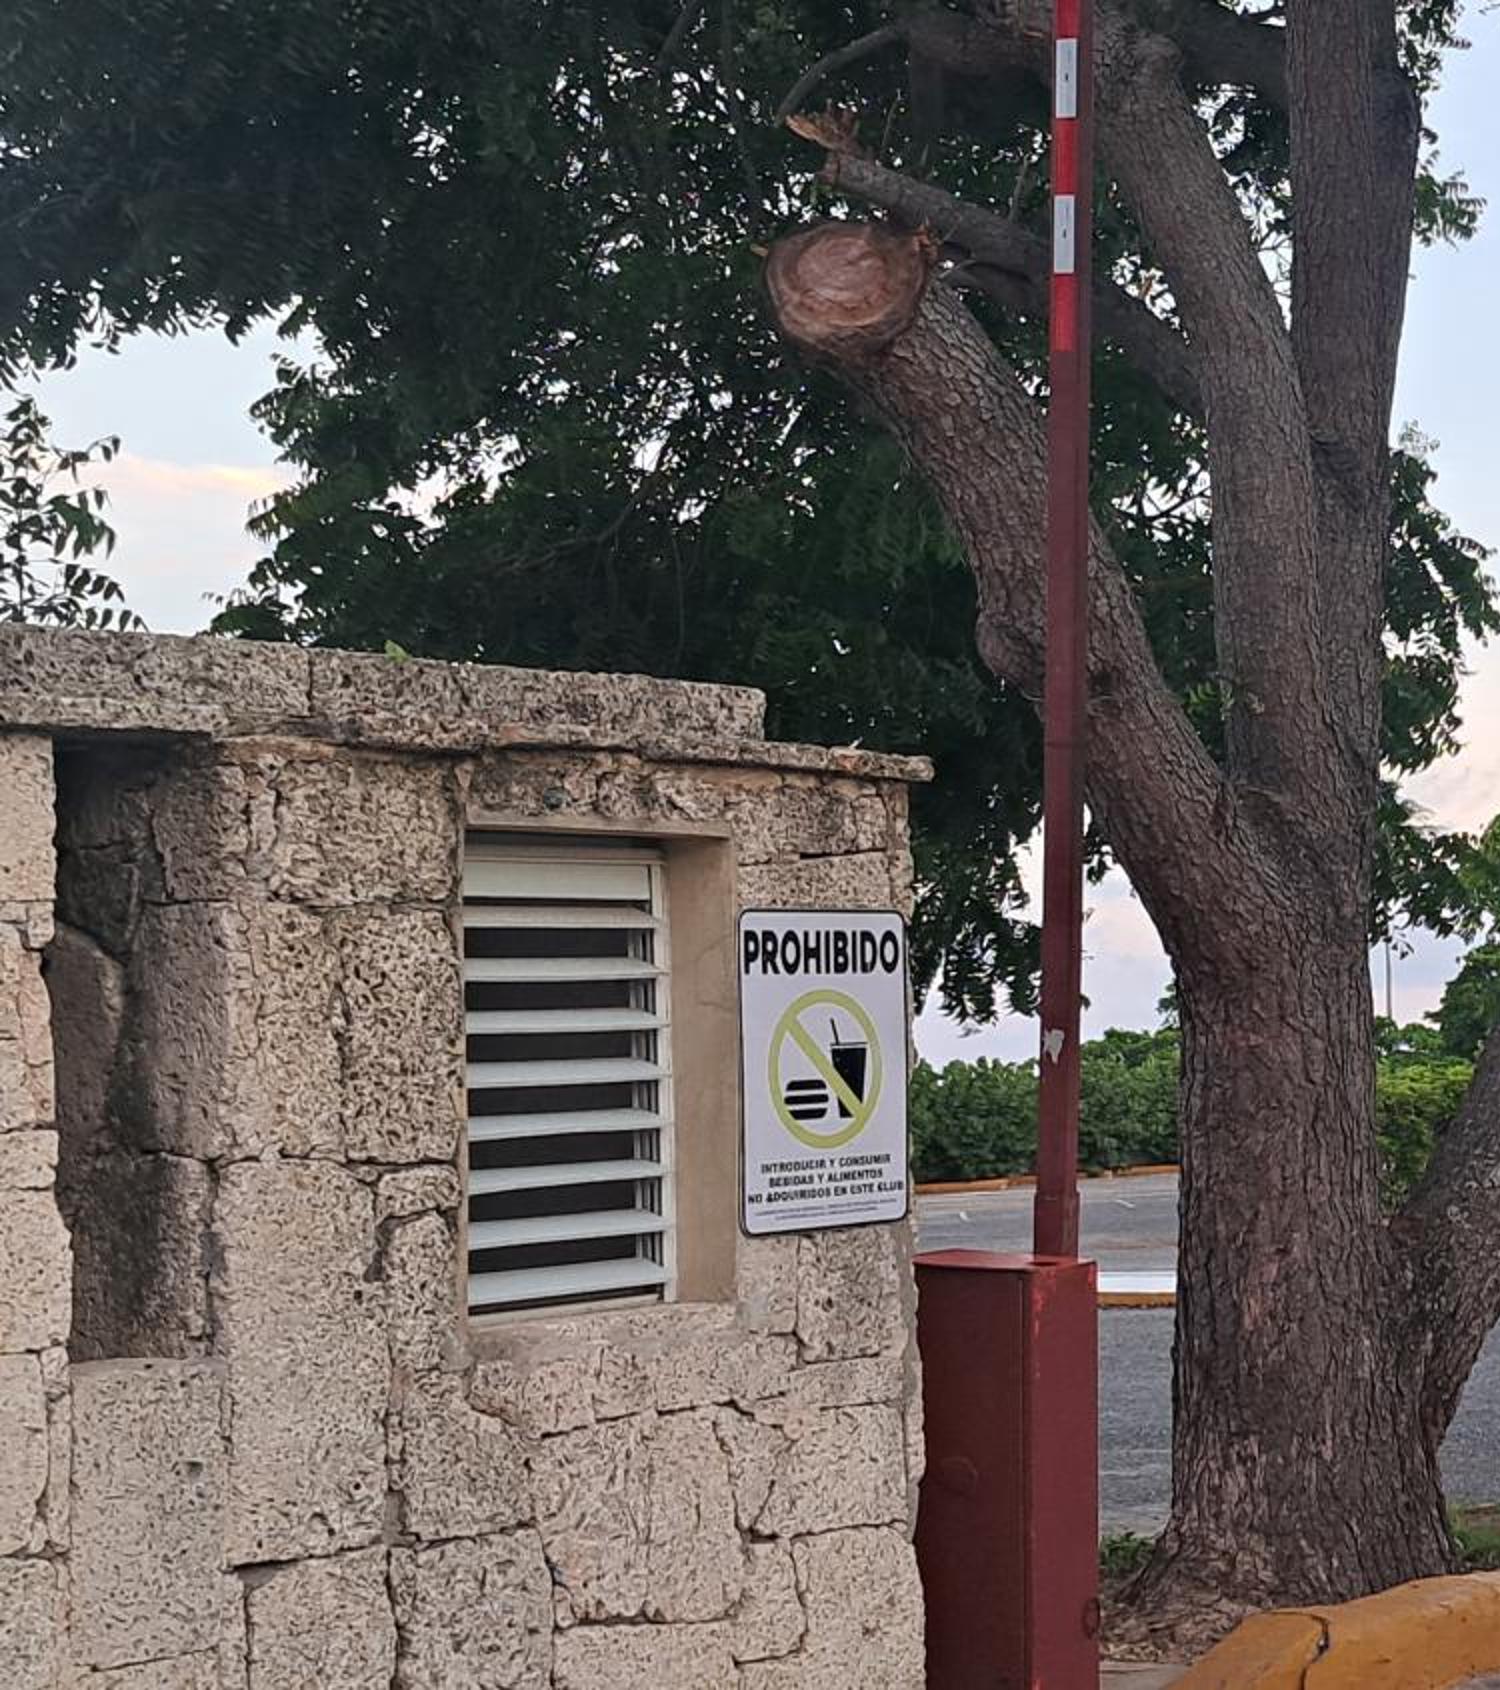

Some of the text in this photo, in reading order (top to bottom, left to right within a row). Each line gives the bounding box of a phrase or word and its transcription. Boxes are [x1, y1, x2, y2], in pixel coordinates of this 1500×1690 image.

[744, 929, 899, 975] PROHIBIDO
[761, 1153, 891, 1174] INTRODUCIR Y CONSUMIR
[769, 1168, 883, 1188] BEBIDAS Y ALIMENTOS
[748, 1180, 904, 1203] NO ADQUIRIDOS EN ESTE CLUB
